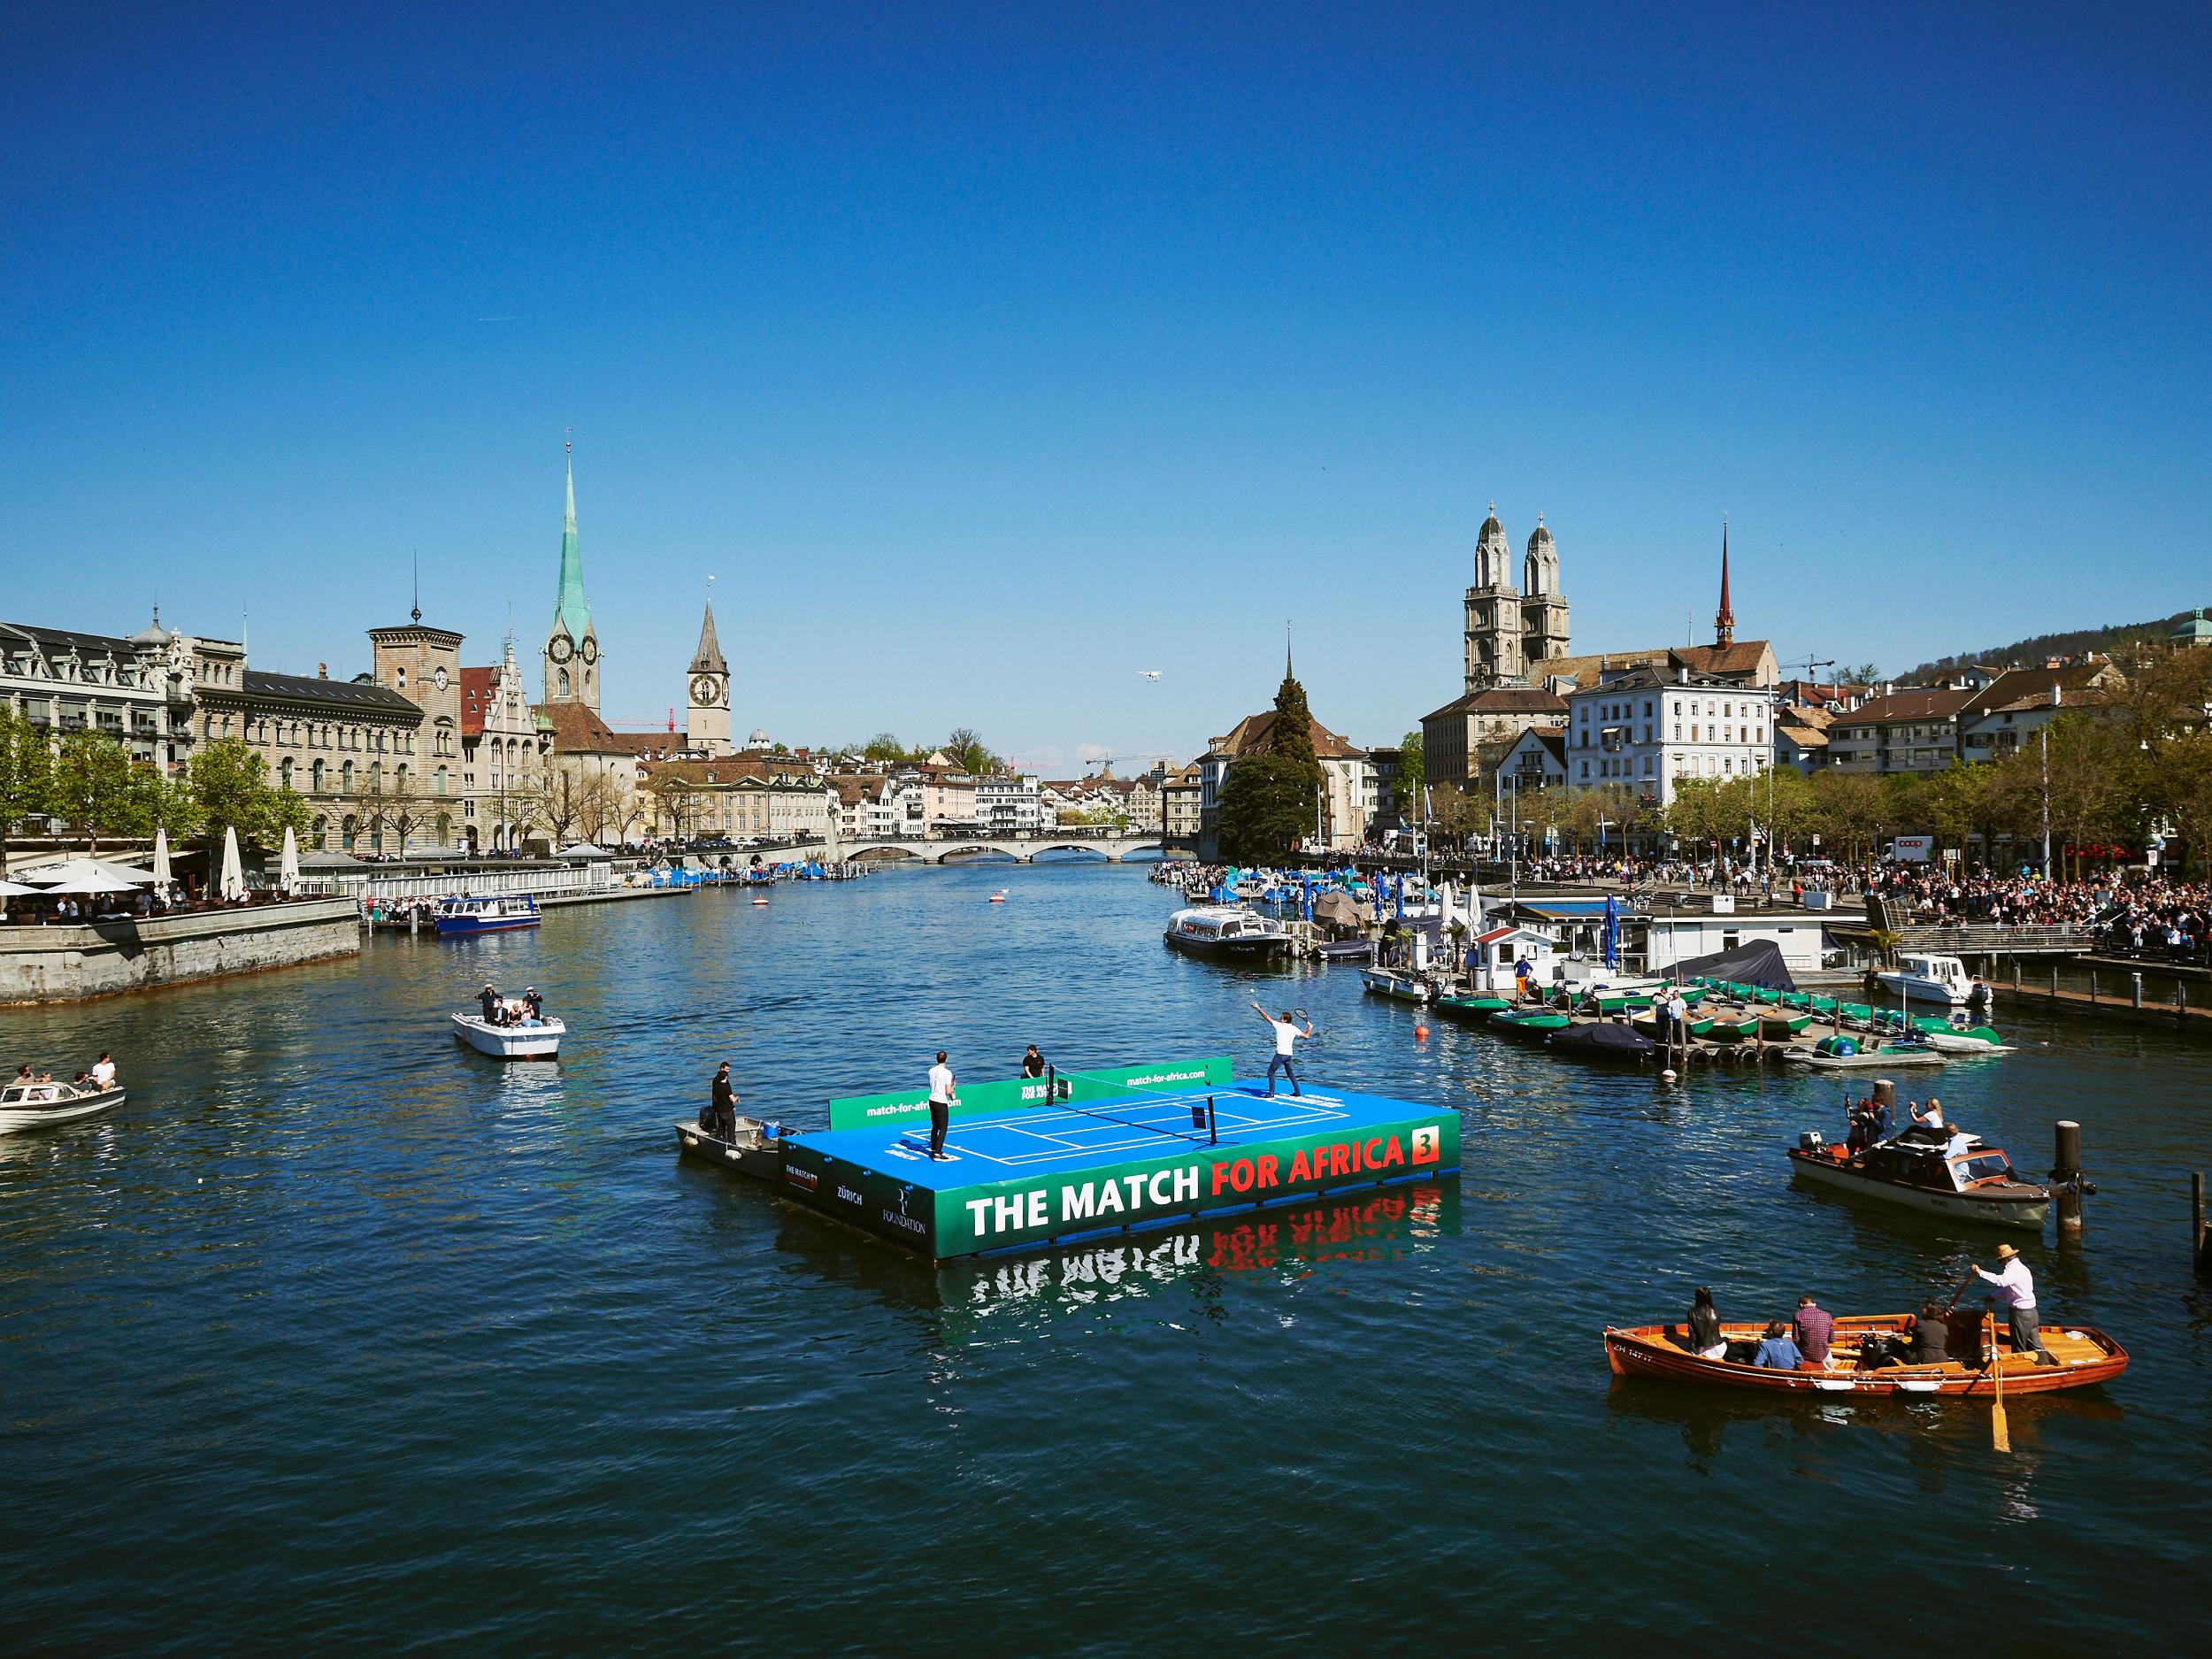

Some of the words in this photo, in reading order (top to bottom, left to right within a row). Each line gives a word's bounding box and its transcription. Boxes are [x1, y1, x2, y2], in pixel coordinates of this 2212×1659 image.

[1126, 1071, 1205, 1087] match-for-africa.com
[786, 1164, 795, 1175] THE
[795, 1167, 810, 1180] MATCH
[965, 1189, 1048, 1236] THE
[1062, 1165, 1199, 1222] MATCH
[1211, 1155, 1279, 1196] FOR
[1288, 1135, 1404, 1184] AFRICA
[1420, 1133, 1432, 1156] 3
[837, 1185, 863, 1206] ZÜRICH
[882, 1209, 926, 1235] FOUNDATION
[1613, 1343, 1626, 1353] ZH
